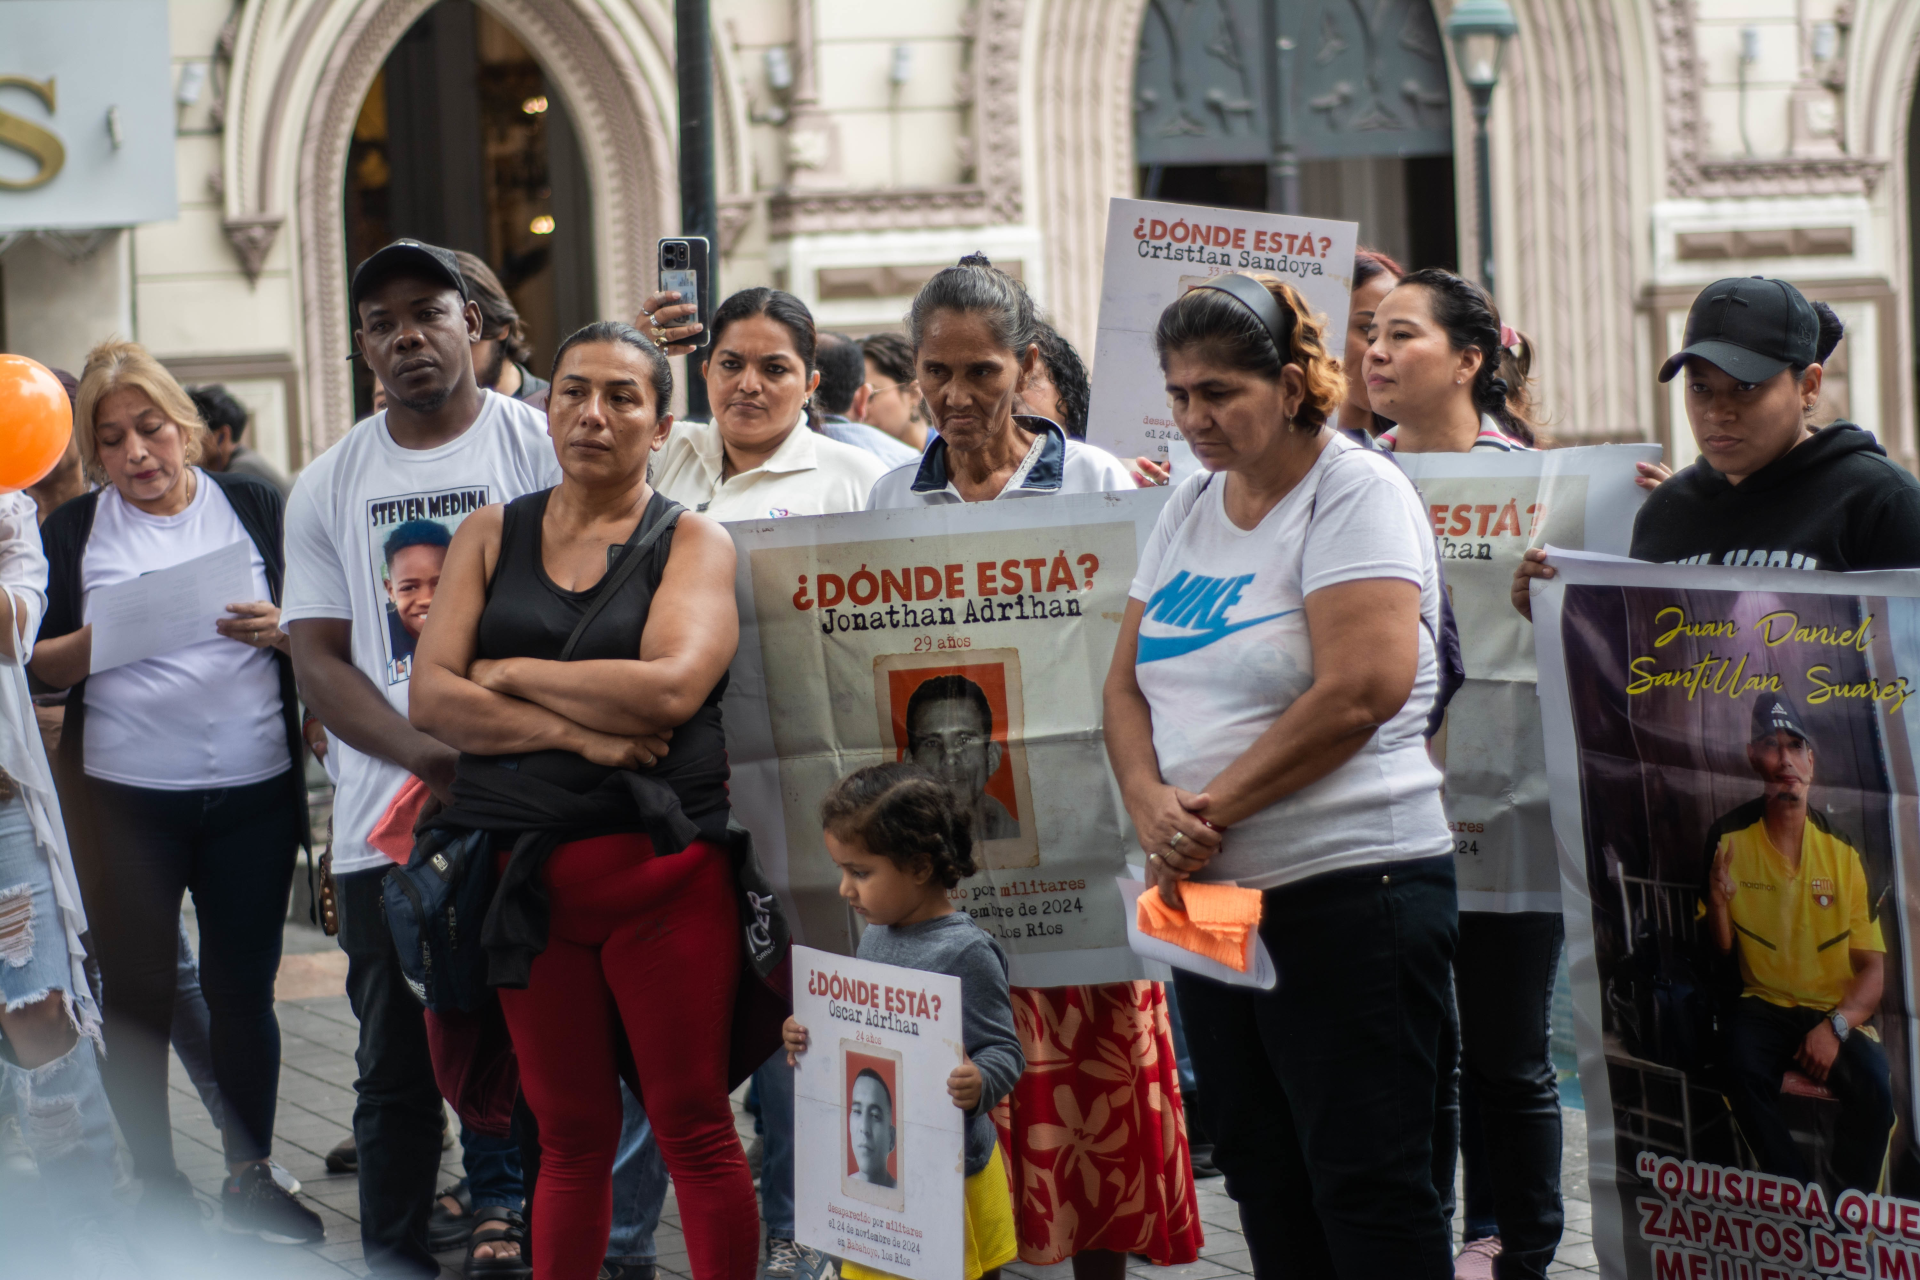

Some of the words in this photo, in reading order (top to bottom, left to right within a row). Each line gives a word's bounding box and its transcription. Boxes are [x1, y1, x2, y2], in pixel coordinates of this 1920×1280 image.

[1133, 217, 1246, 250] ¿DÓNDE
[1252, 230, 1332, 259] ESTÁ?
[1138, 239, 1231, 266] Cristian
[1237, 250, 1323, 277] Sandoya
[1145, 430, 1156, 439] el
[1159, 431, 1171, 440] 24
[371, 497, 426, 527] STEVEN
[428, 490, 487, 519] MEDINA
[1429, 497, 1548, 538] ESTÁ?
[792, 563, 965, 611] ¿DÓNDE
[976, 549, 1099, 597] ESTÁ?
[822, 602, 956, 634] Jonathan
[962, 593, 1083, 624] Adrihan
[1143, 569, 1257, 630] NIKE
[913, 636, 932, 652] 29
[937, 634, 971, 649] años
[1654, 606, 1739, 648] Juan
[1753, 609, 1877, 652] Daniel
[1625, 651, 1784, 701] Santillan
[1806, 663, 1916, 714] Suarez
[972, 885, 996, 900] por
[1000, 879, 1086, 897] militares
[1018, 902, 1037, 917] de
[1042, 897, 1083, 915] 2024
[999, 924, 1022, 939] los
[808, 969, 880, 1009] ¿DÓNDE
[884, 988, 942, 1022] ESTÁ?
[829, 1000, 862, 1023] Oscar
[865, 1008, 920, 1036] Adrihan
[855, 1030, 865, 1042] 24
[1639, 1156, 1830, 1226] “QUISIERA
[1839, 1194, 1920, 1241] QUE
[827, 1202, 871, 1224] desaparecido
[872, 1217, 885, 1228] por
[885, 1220, 923, 1238] militares
[828, 1218, 836, 1229] el
[837, 1220, 845, 1232] 24
[855, 1228, 891, 1246] noviembre
[892, 1236, 901, 1248] de
[902, 1240, 921, 1255] 2024
[1640, 1201, 1804, 1263] ZAPATOS
[1814, 1233, 1867, 1275] DE
[846, 1238, 880, 1259] Babahoyo,
[881, 1249, 893, 1262] los
